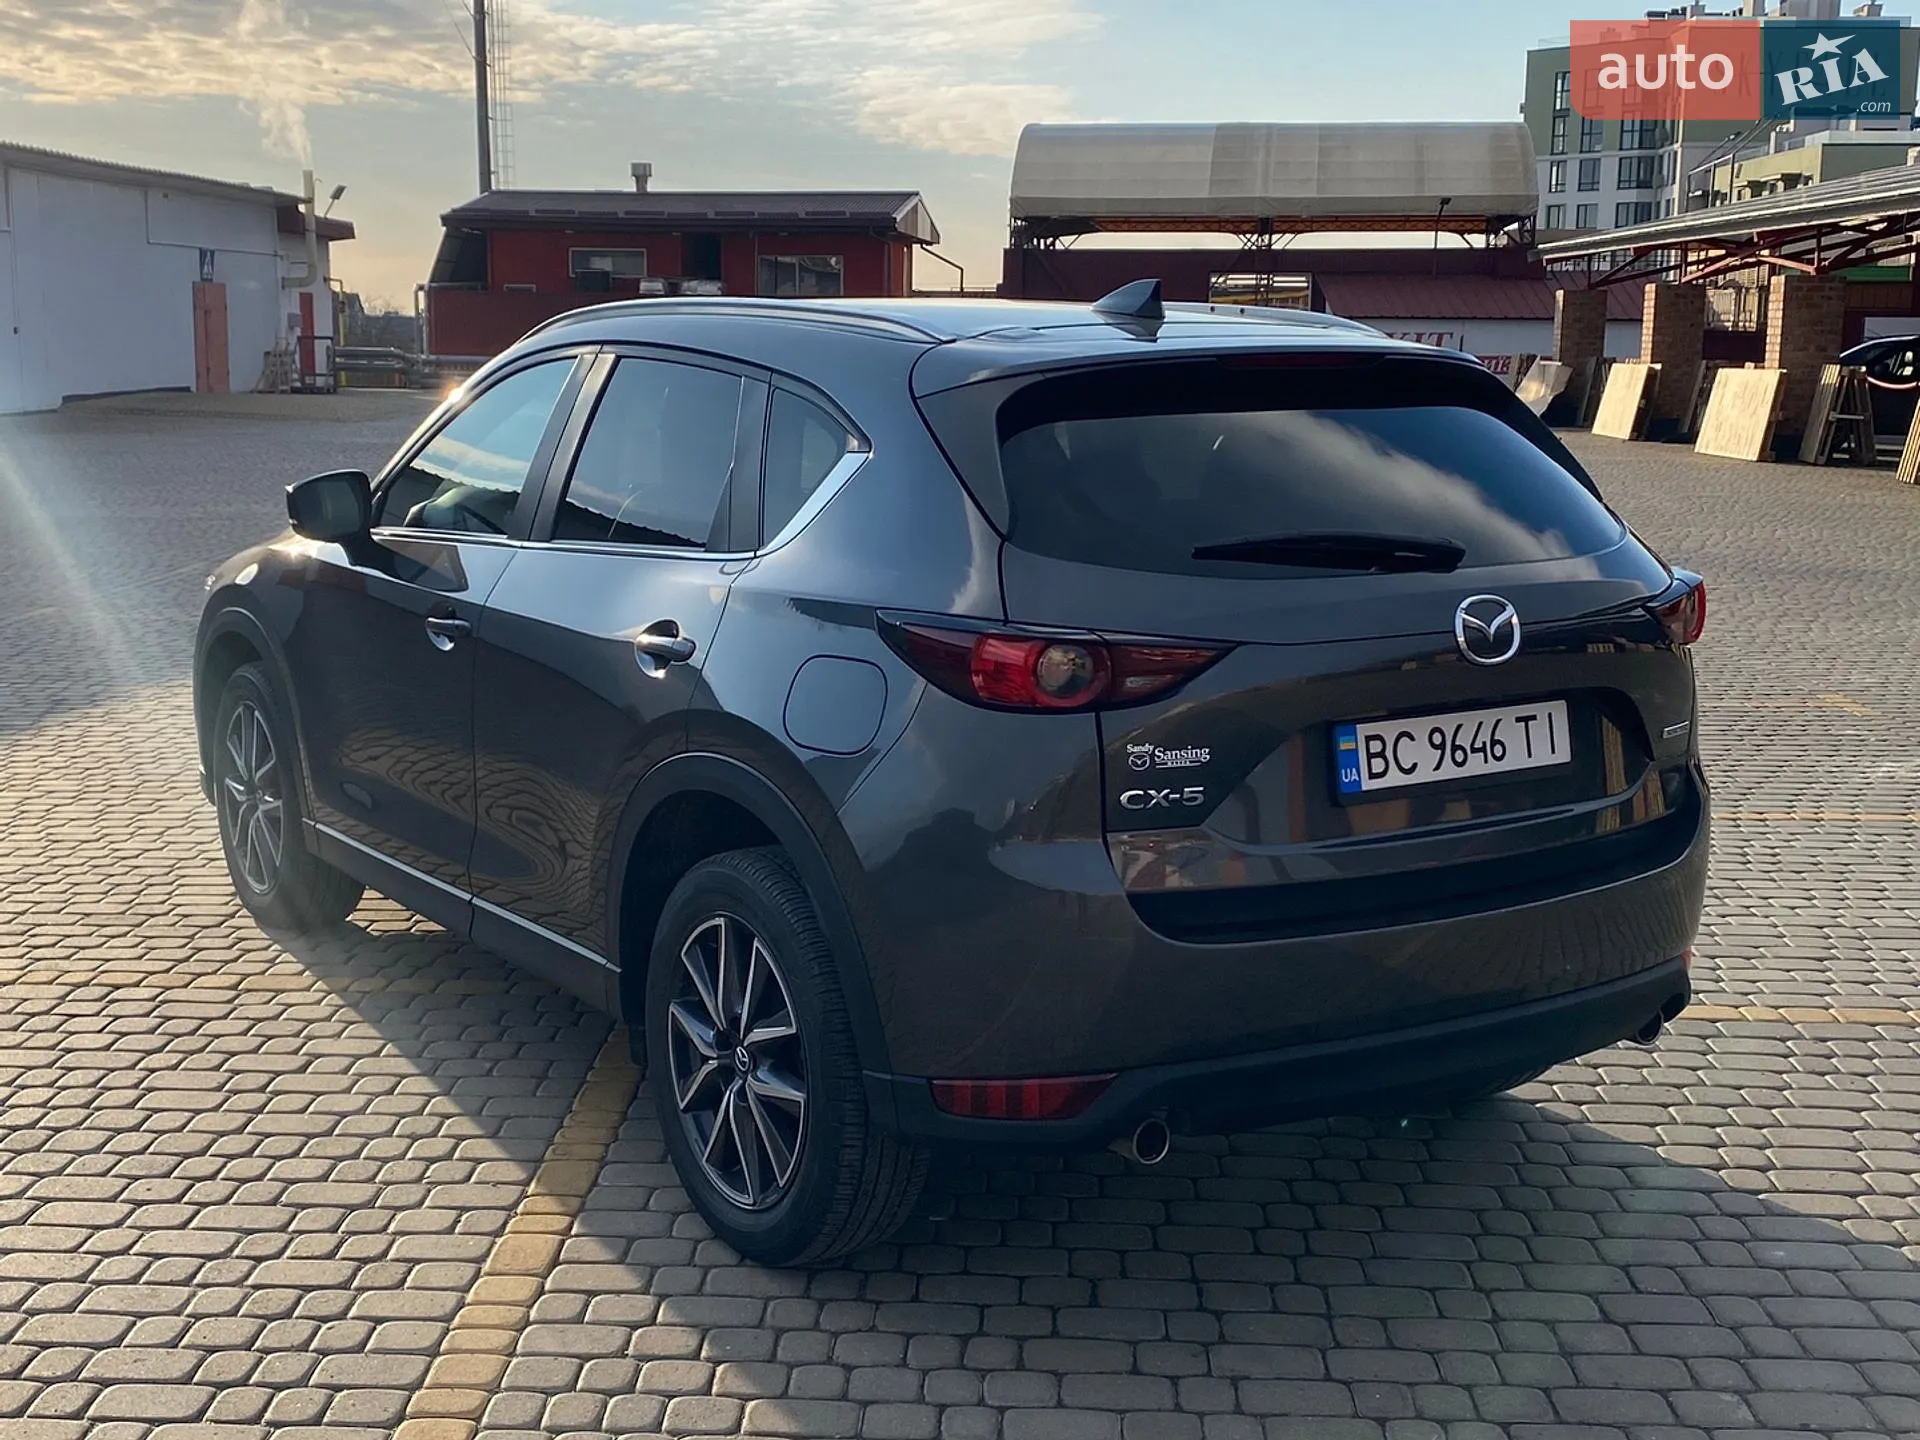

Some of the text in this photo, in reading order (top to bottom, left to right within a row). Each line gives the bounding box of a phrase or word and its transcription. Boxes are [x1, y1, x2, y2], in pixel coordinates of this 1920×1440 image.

[1126, 743, 1154, 754] Sandy
[1154, 745, 1211, 763] Sansing
[1364, 711, 1557, 780] BC 9646 TI
[1342, 767, 1360, 783] UA
[1119, 786, 1205, 810] CX-5
